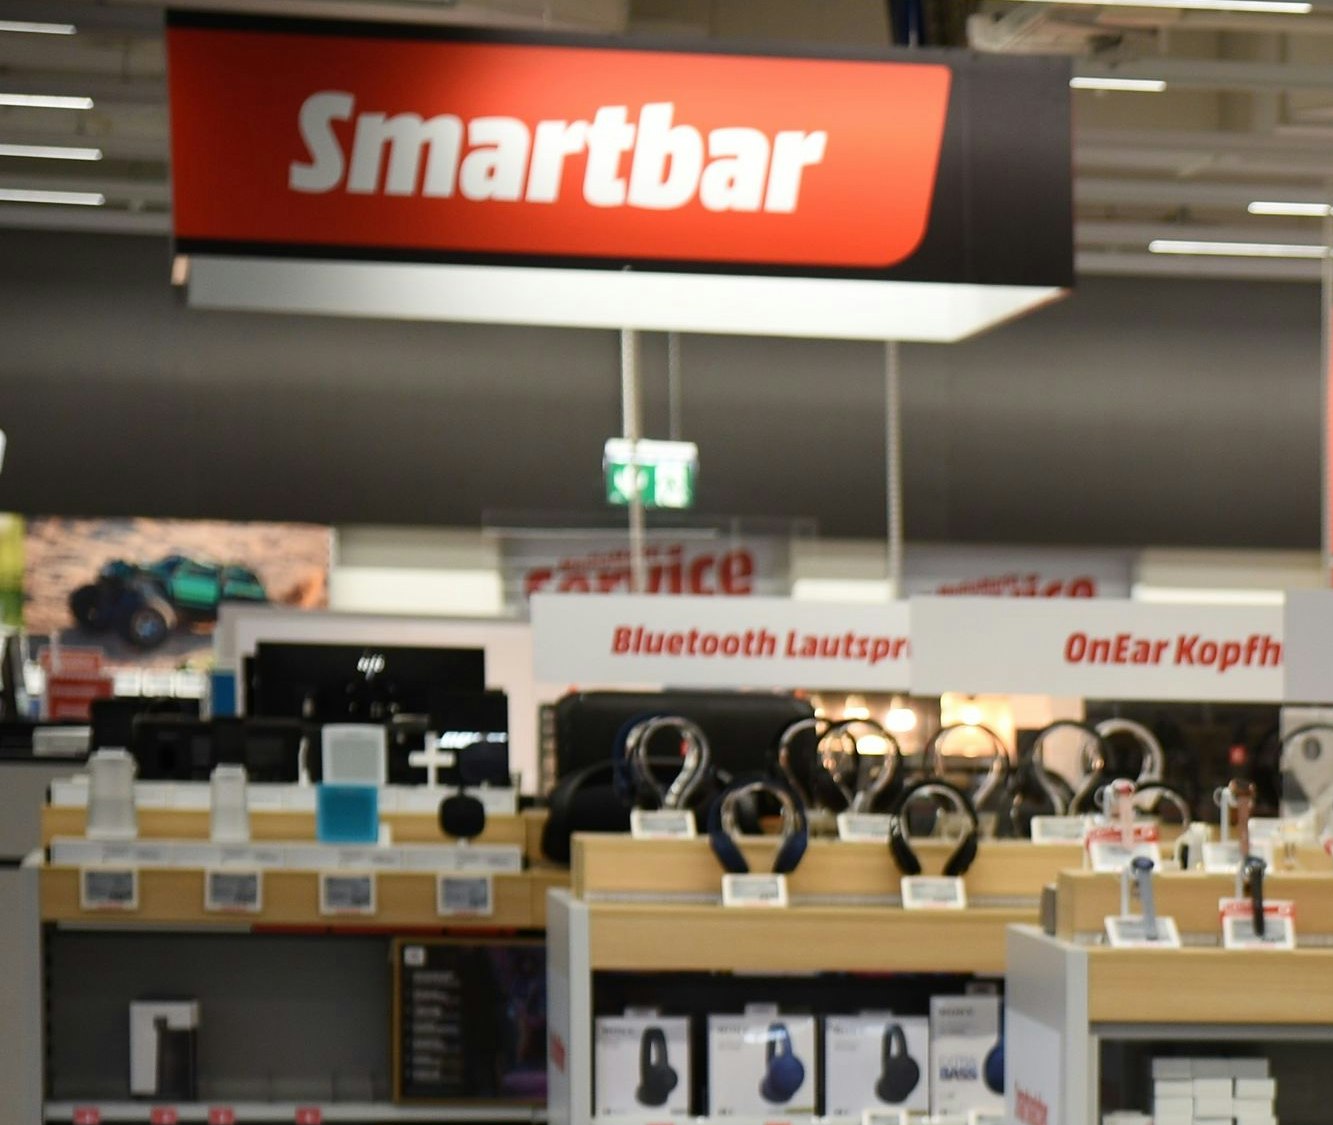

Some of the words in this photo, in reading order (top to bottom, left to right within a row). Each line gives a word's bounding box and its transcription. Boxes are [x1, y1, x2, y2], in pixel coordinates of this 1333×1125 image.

[288, 90, 827, 214] Smartbar
[611, 625, 777, 656] Bluetooth
[1064, 632, 1169, 665] OnEar
